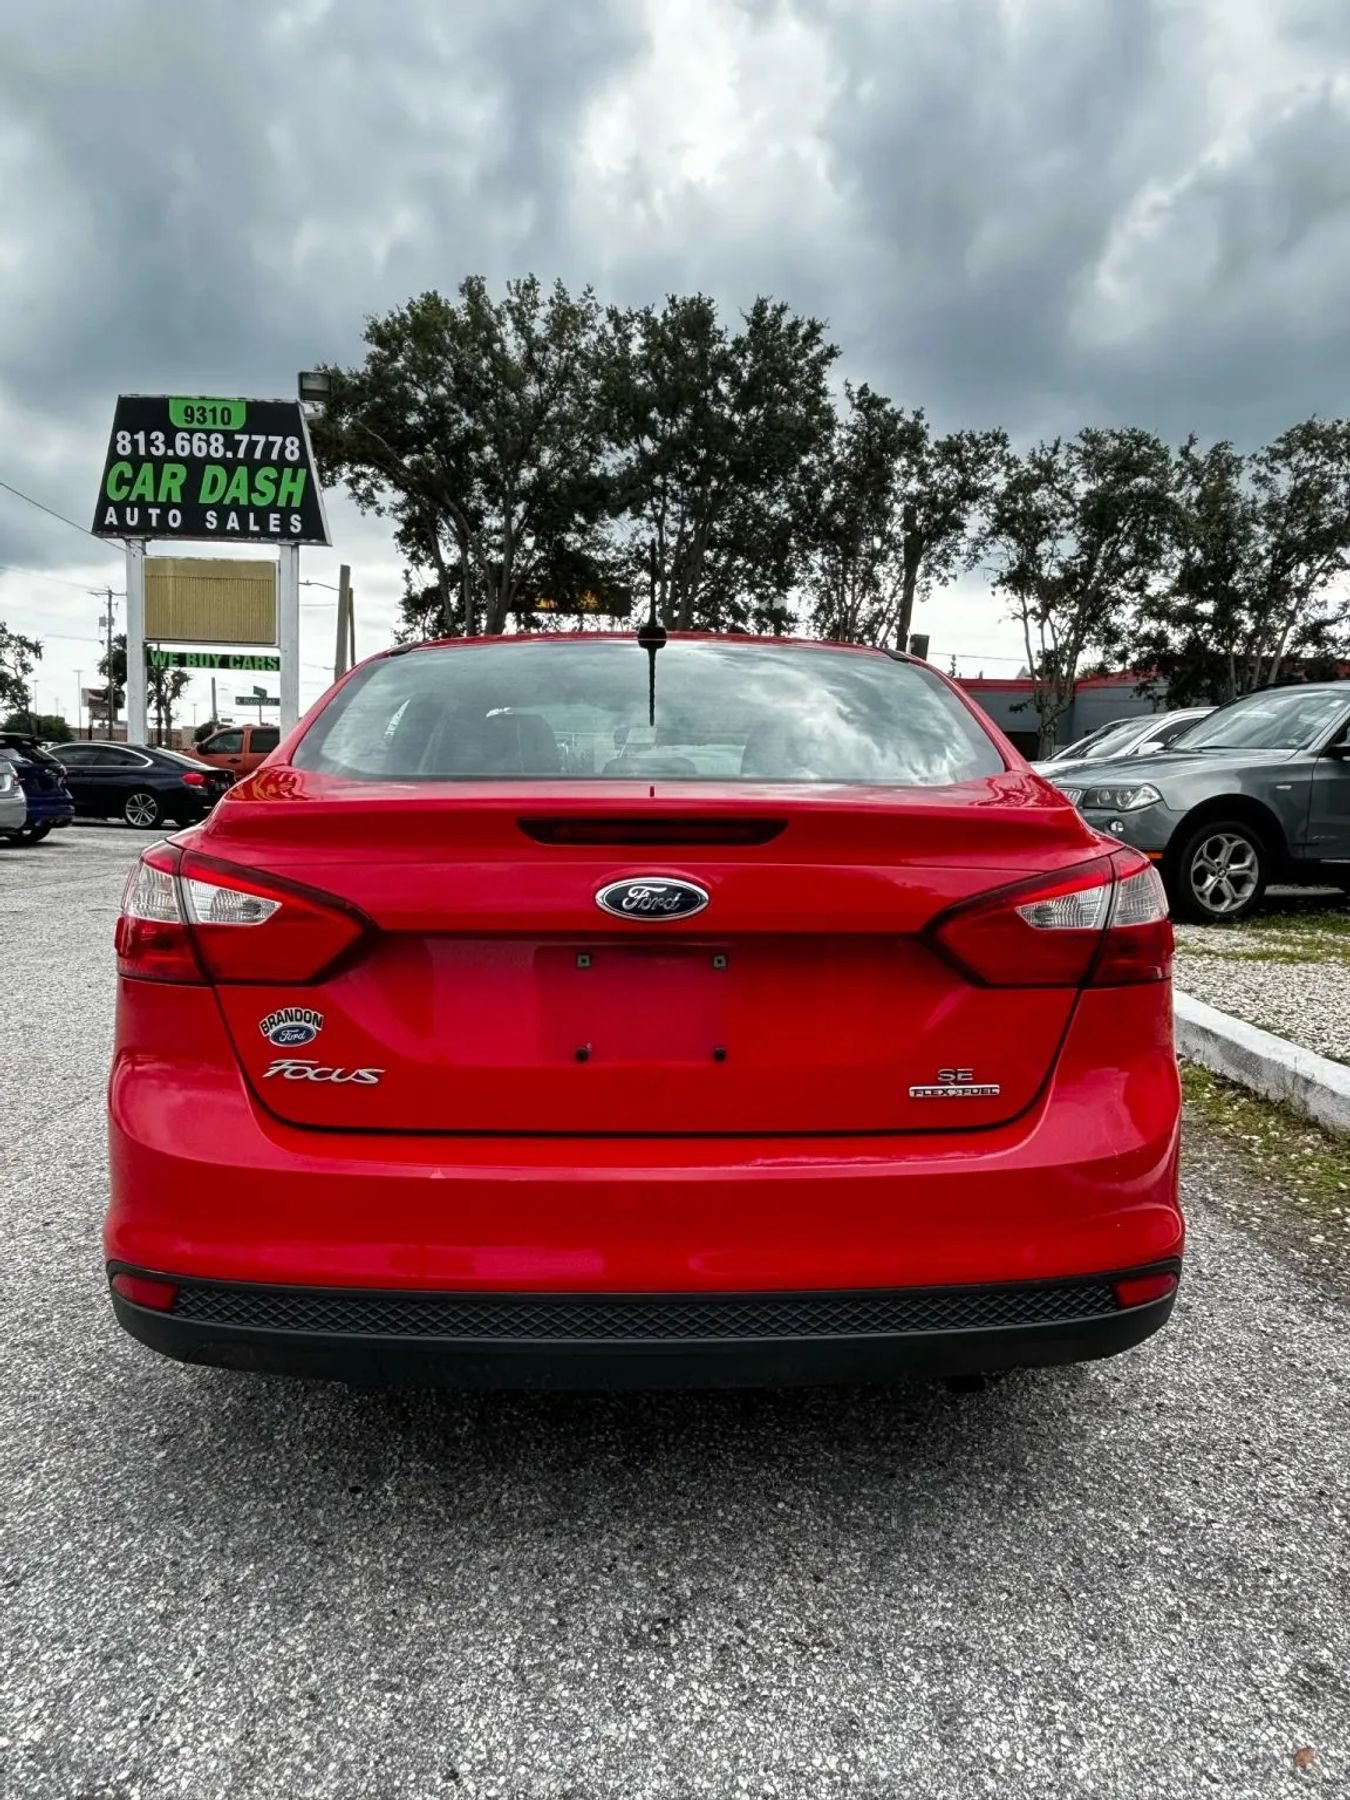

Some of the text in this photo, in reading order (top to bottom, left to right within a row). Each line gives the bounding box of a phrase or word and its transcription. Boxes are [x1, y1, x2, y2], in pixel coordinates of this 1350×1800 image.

[183, 405, 232, 426] 9310
[116, 430, 300, 462] 813.668.7778
[106, 461, 307, 507] CAR DASH
[104, 506, 302, 533] AUTO SALES
[151, 651, 278, 671] WE BUY CARS
[622, 885, 682, 911] Ford
[260, 1008, 323, 1035] BRANDON
[278, 1029, 307, 1042] Ford
[937, 1068, 974, 1081] SE
